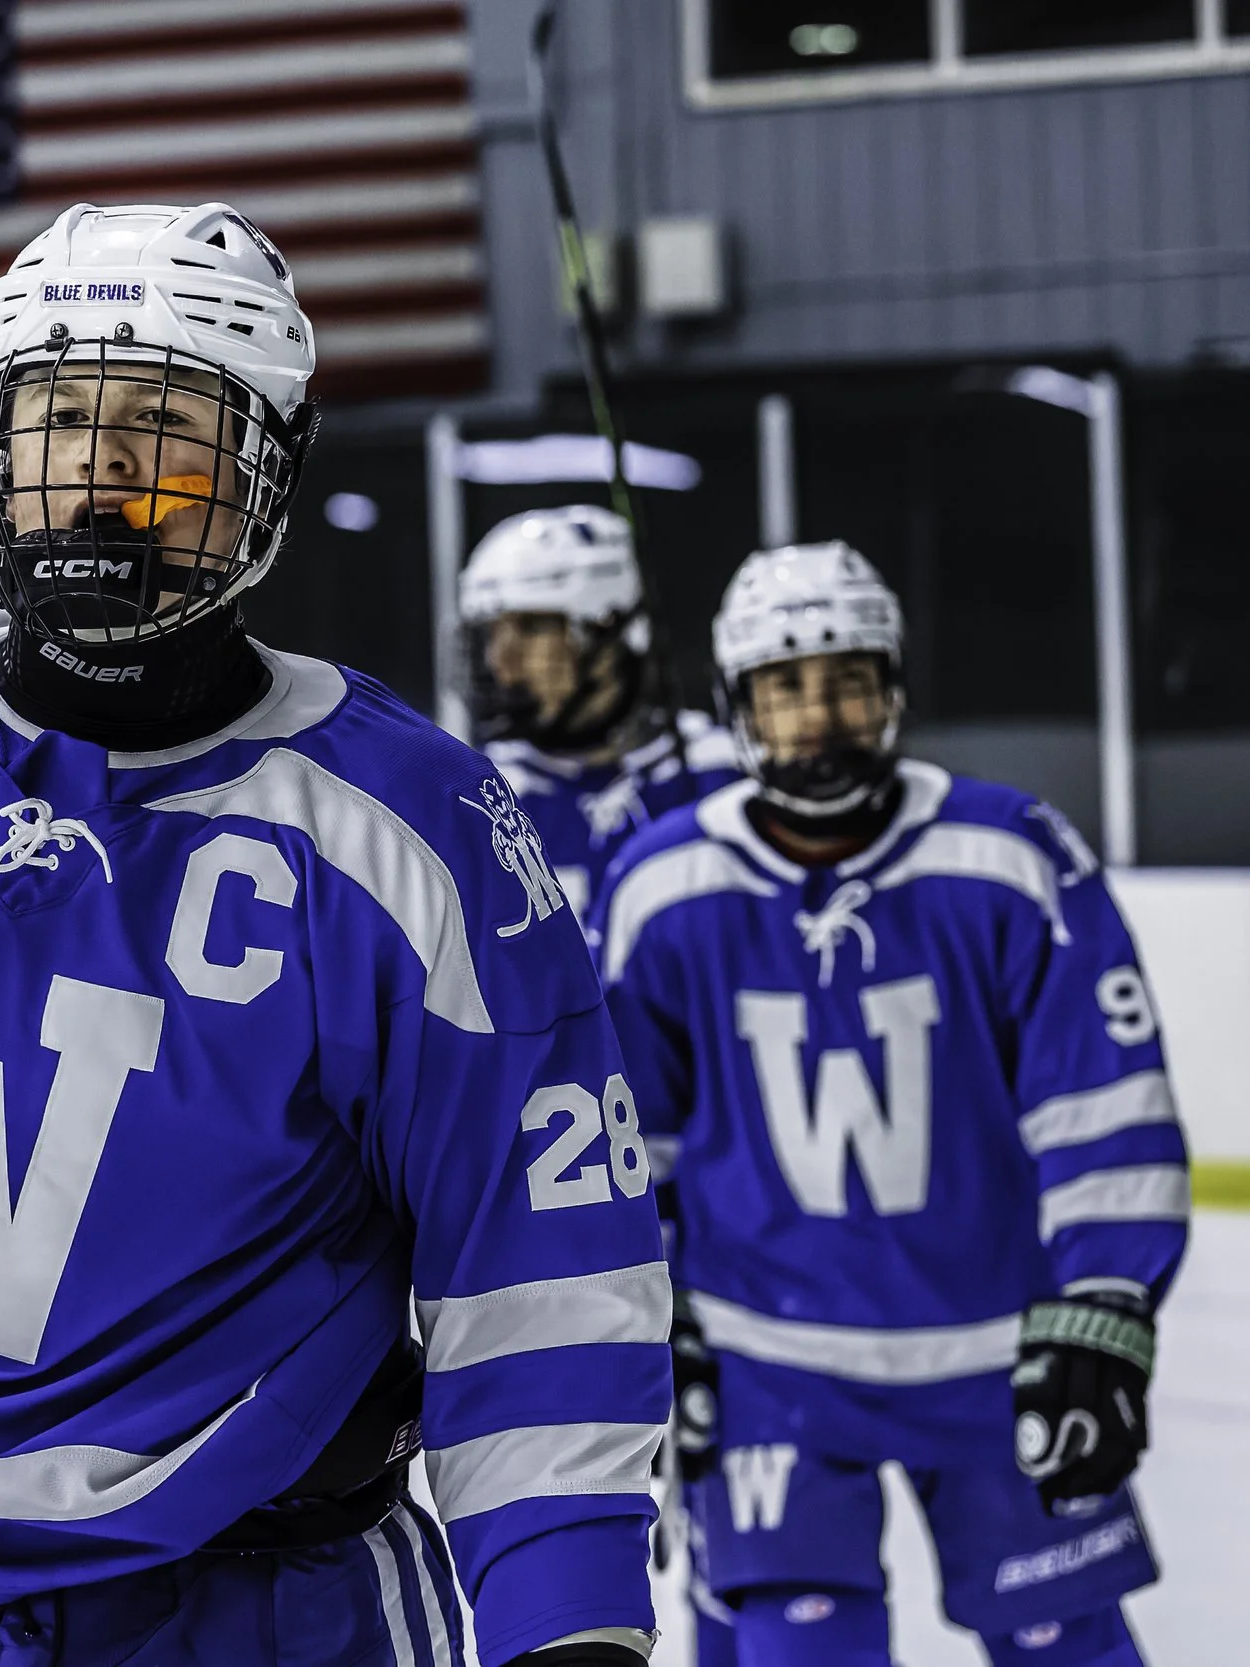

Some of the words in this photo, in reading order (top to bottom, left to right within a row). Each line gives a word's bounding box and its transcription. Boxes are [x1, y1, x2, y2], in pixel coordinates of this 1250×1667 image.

[44, 284, 82, 301] BLUE
[86, 284, 142, 301] DEVILS
[33, 559, 133, 579] CCM
[39, 641, 144, 683] BAUER
[165, 832, 298, 1004] C
[736, 975, 940, 1217] W
[521, 1073, 650, 1212] 28
[723, 1443, 798, 1532] W
